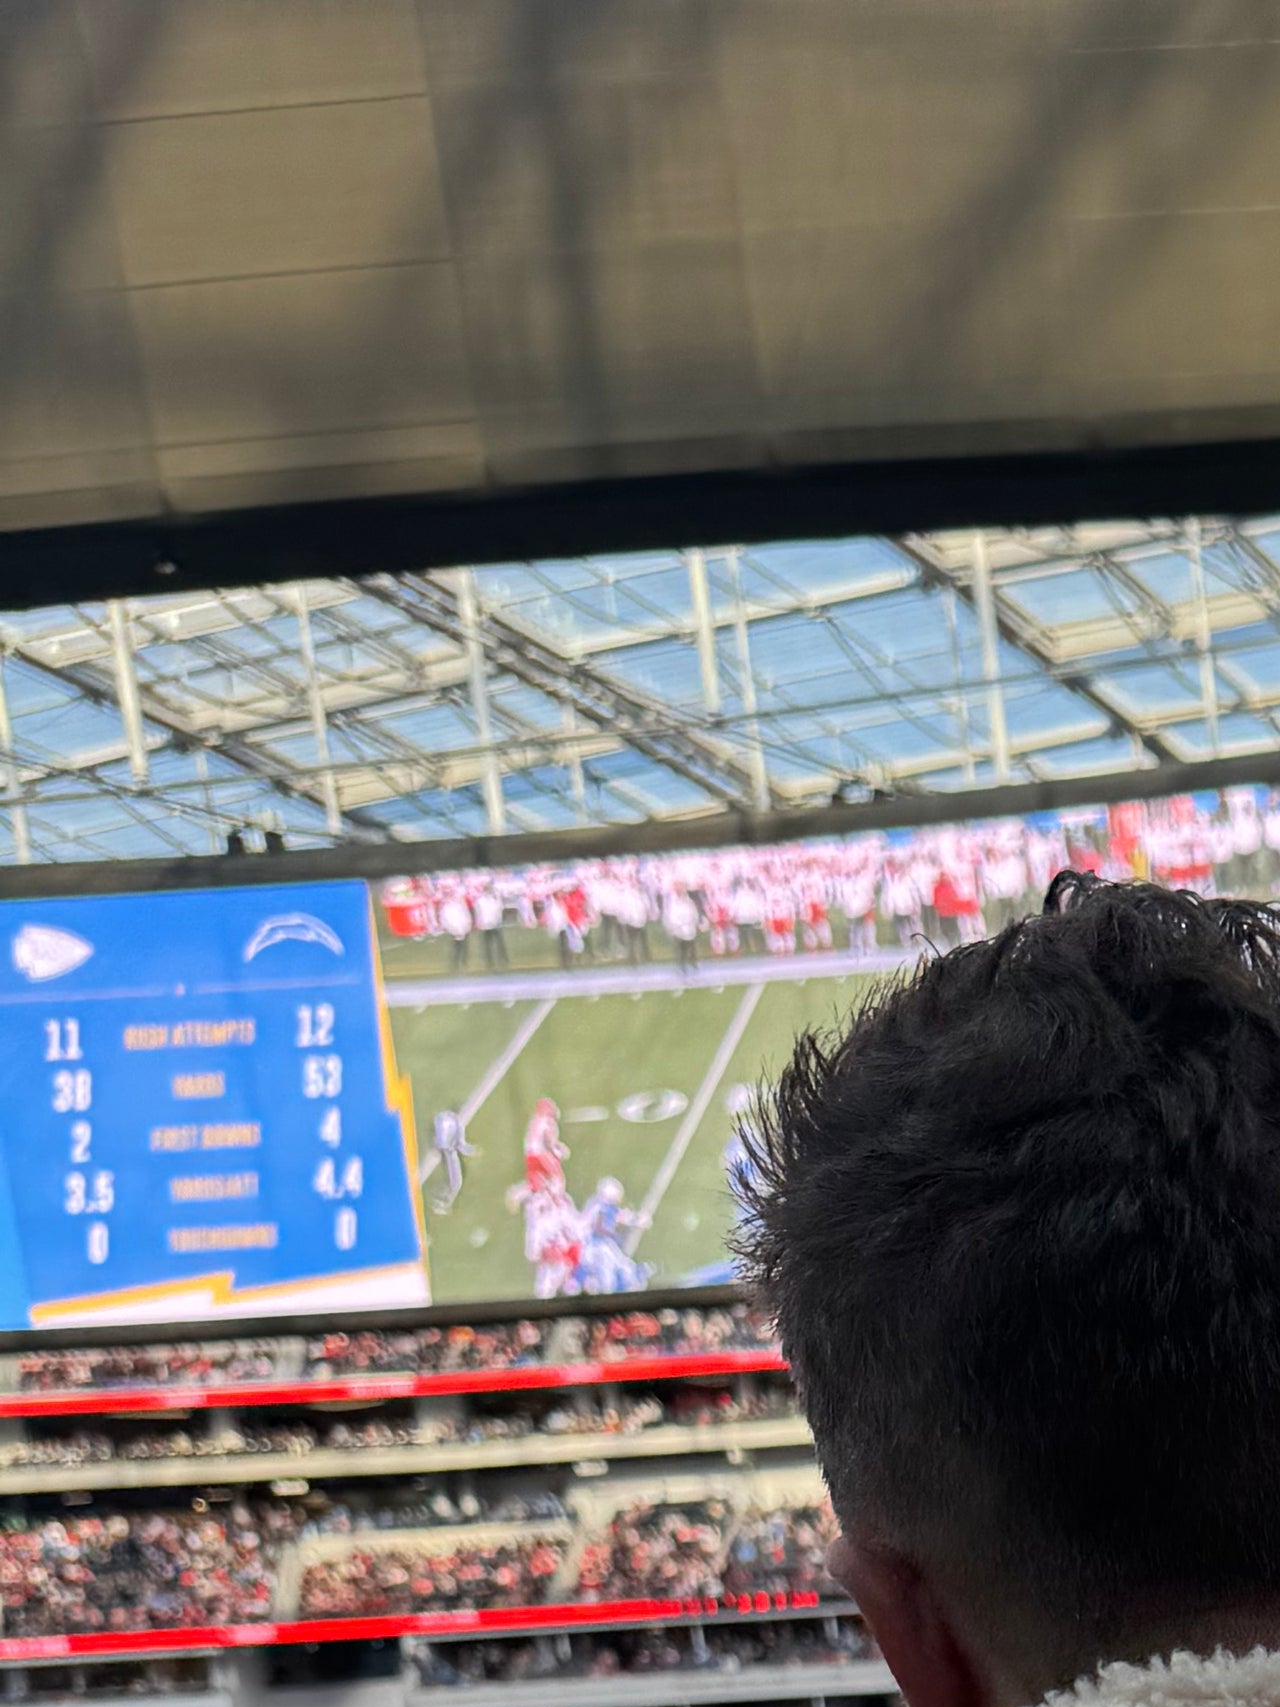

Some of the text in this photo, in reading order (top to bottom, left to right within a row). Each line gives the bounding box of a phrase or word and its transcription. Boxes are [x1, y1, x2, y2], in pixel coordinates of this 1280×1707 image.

[45, 1018, 83, 1062] 11
[295, 1002, 335, 1048] 12
[302, 1054, 342, 1099] 53
[70, 1120, 92, 1163] 2
[319, 1105, 341, 1149] 4
[313, 1155, 363, 1200] 4.4
[88, 1221, 109, 1264] 0
[335, 1206, 357, 1250] 0
